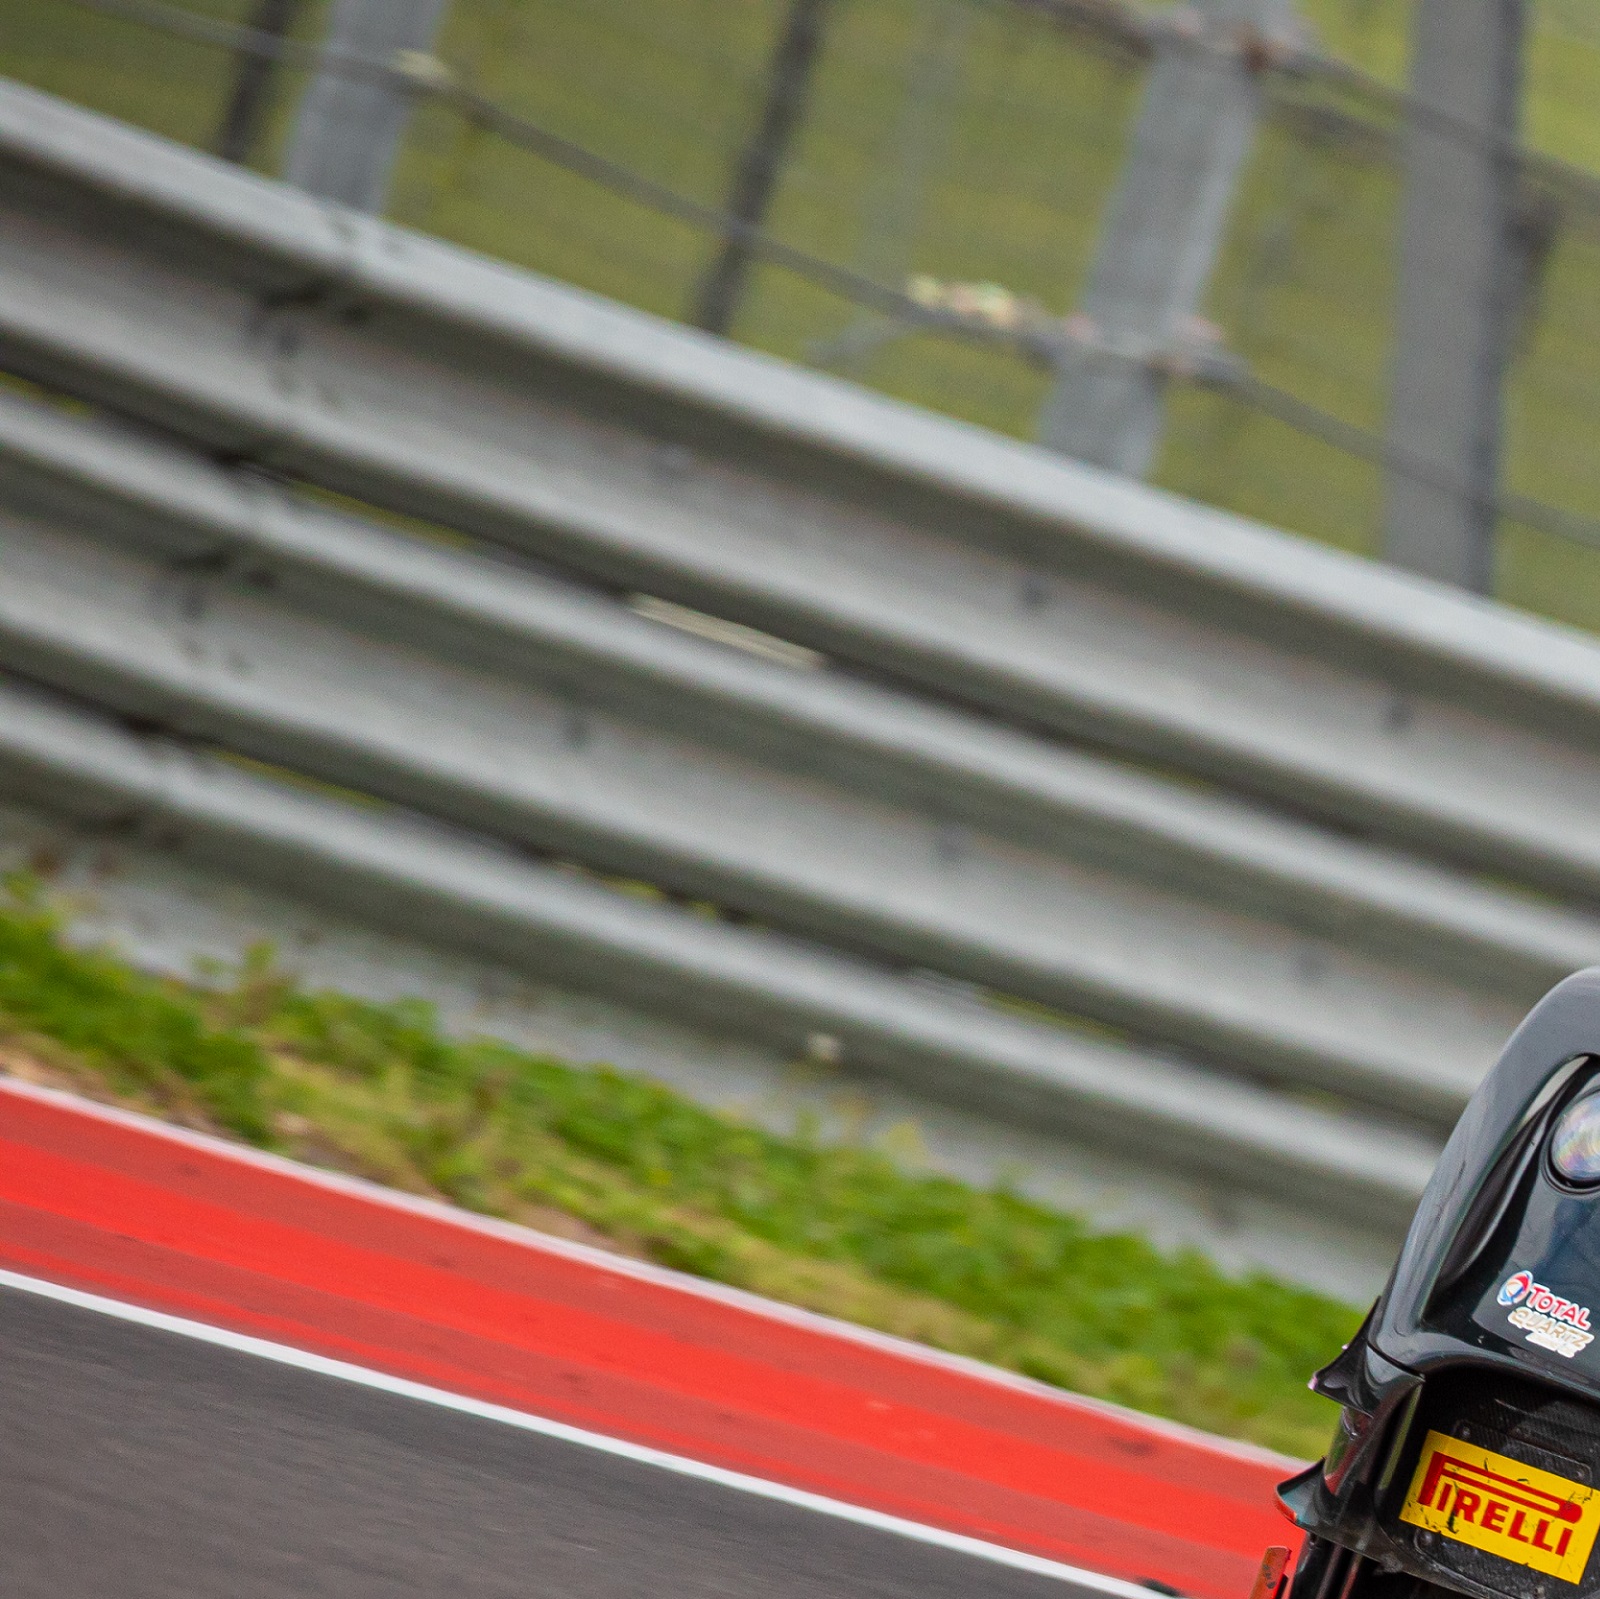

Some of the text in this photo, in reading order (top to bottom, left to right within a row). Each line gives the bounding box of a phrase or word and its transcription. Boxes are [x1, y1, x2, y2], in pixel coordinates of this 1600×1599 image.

[1511, 1309, 1593, 1346] QUARTZ
[1528, 1286, 1590, 1329] TOTAL
[1417, 1451, 1582, 1557] PIRELLI
